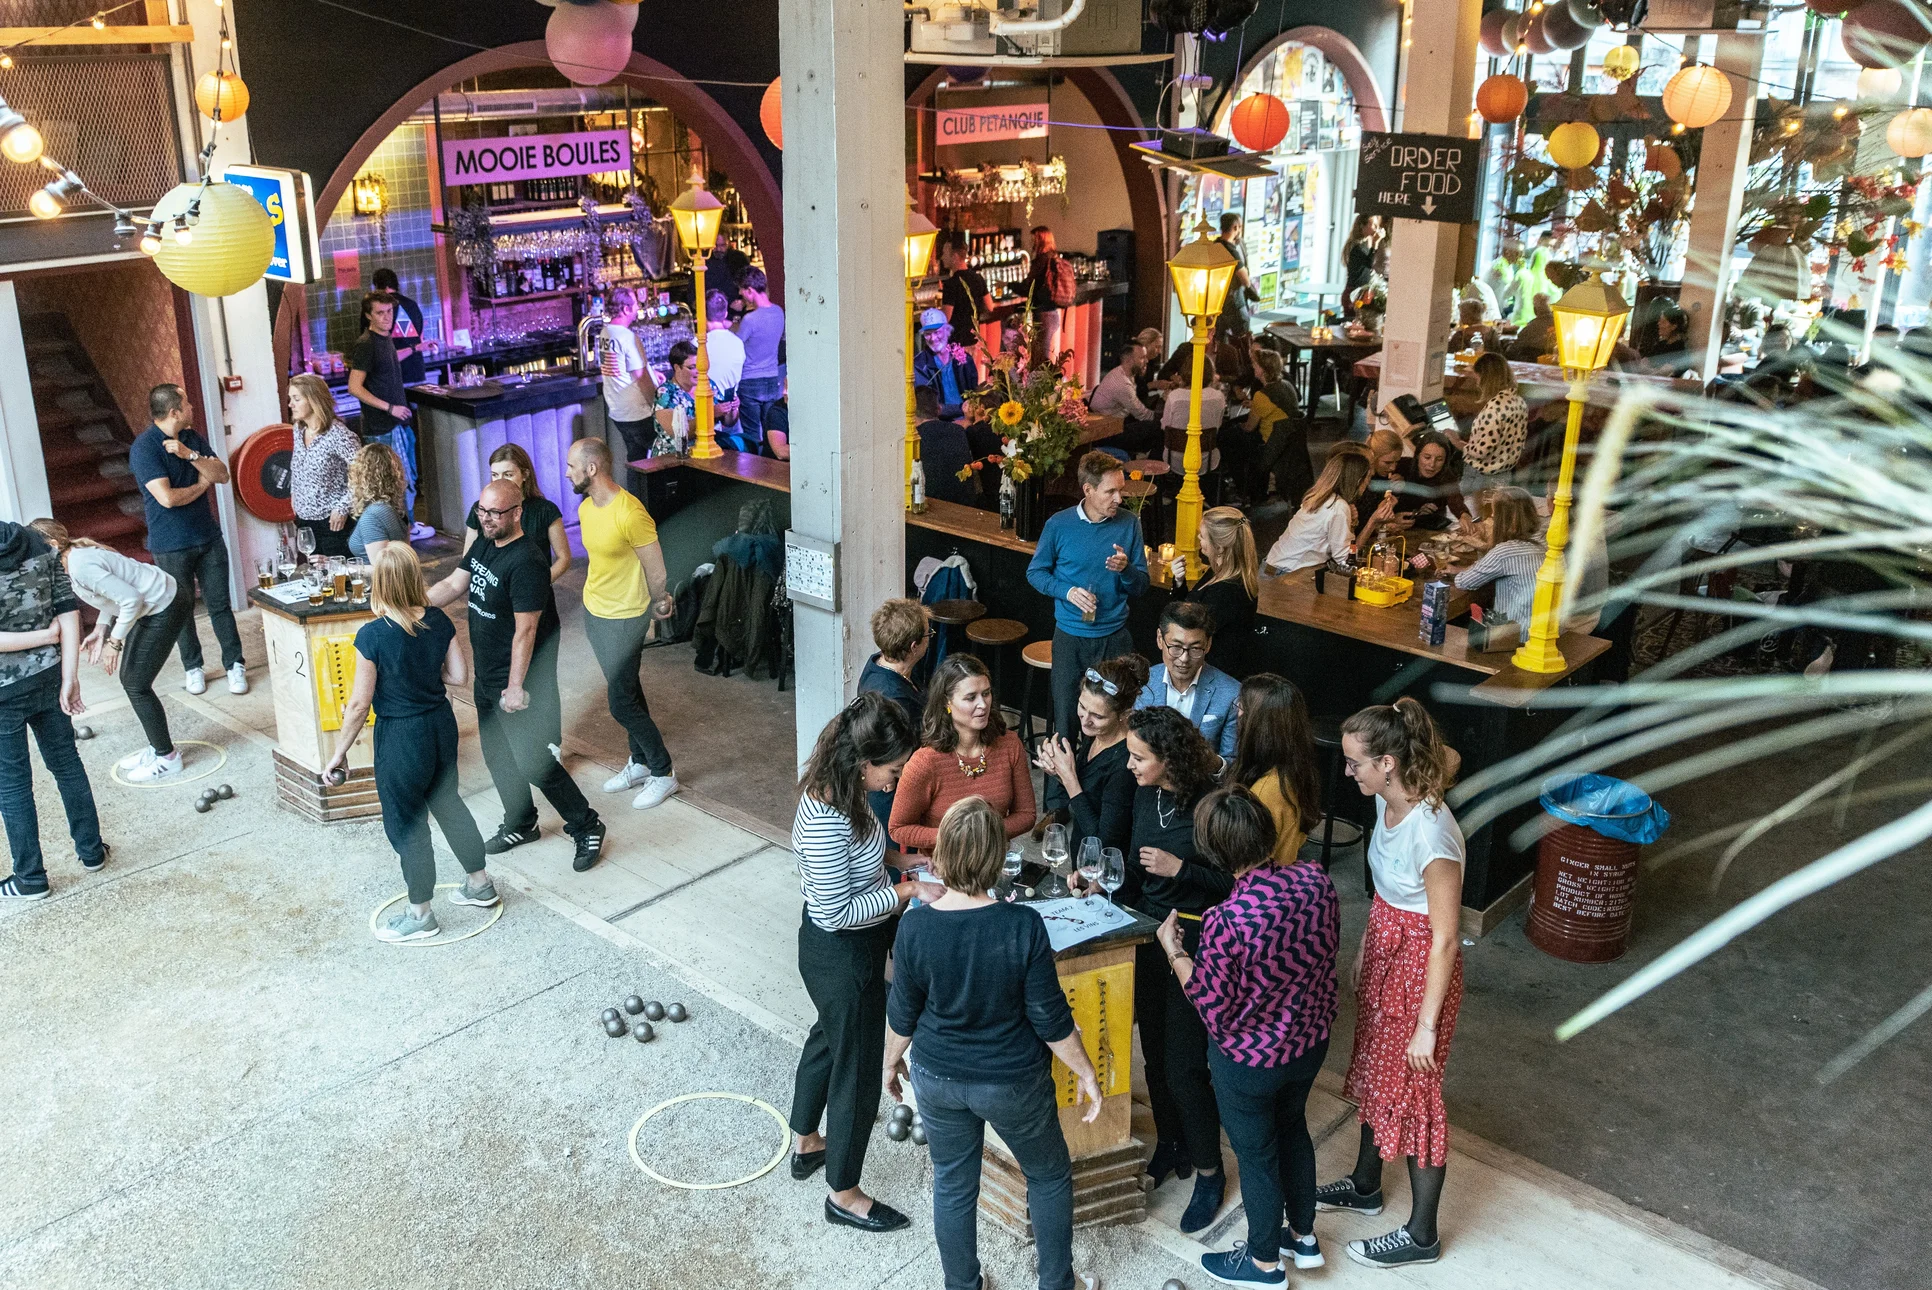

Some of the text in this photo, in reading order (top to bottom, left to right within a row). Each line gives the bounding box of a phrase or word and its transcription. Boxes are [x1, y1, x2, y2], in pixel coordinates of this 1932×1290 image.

[943, 111, 1043, 136] CLUB PETANQUE
[455, 139, 621, 175] MOOIE BOULES
[1390, 145, 1462, 173] ORDER
[1400, 171, 1462, 195] FOOD
[1378, 191, 1412, 206] HERE
[272, 639, 306, 678] 1 2
[1560, 856, 1590, 869] GINGER
[1557, 876, 1582, 888] GROSS
[1558, 870, 1573, 880] NET
[1555, 889, 1570, 899] LOT
[1556, 883, 1591, 898] PRODUCT
[1554, 895, 1578, 908] BATCH
[1051, 907, 1069, 915] TEAM
[1552, 901, 1572, 912] BEST
[1576, 909, 1606, 919] BEFORE
